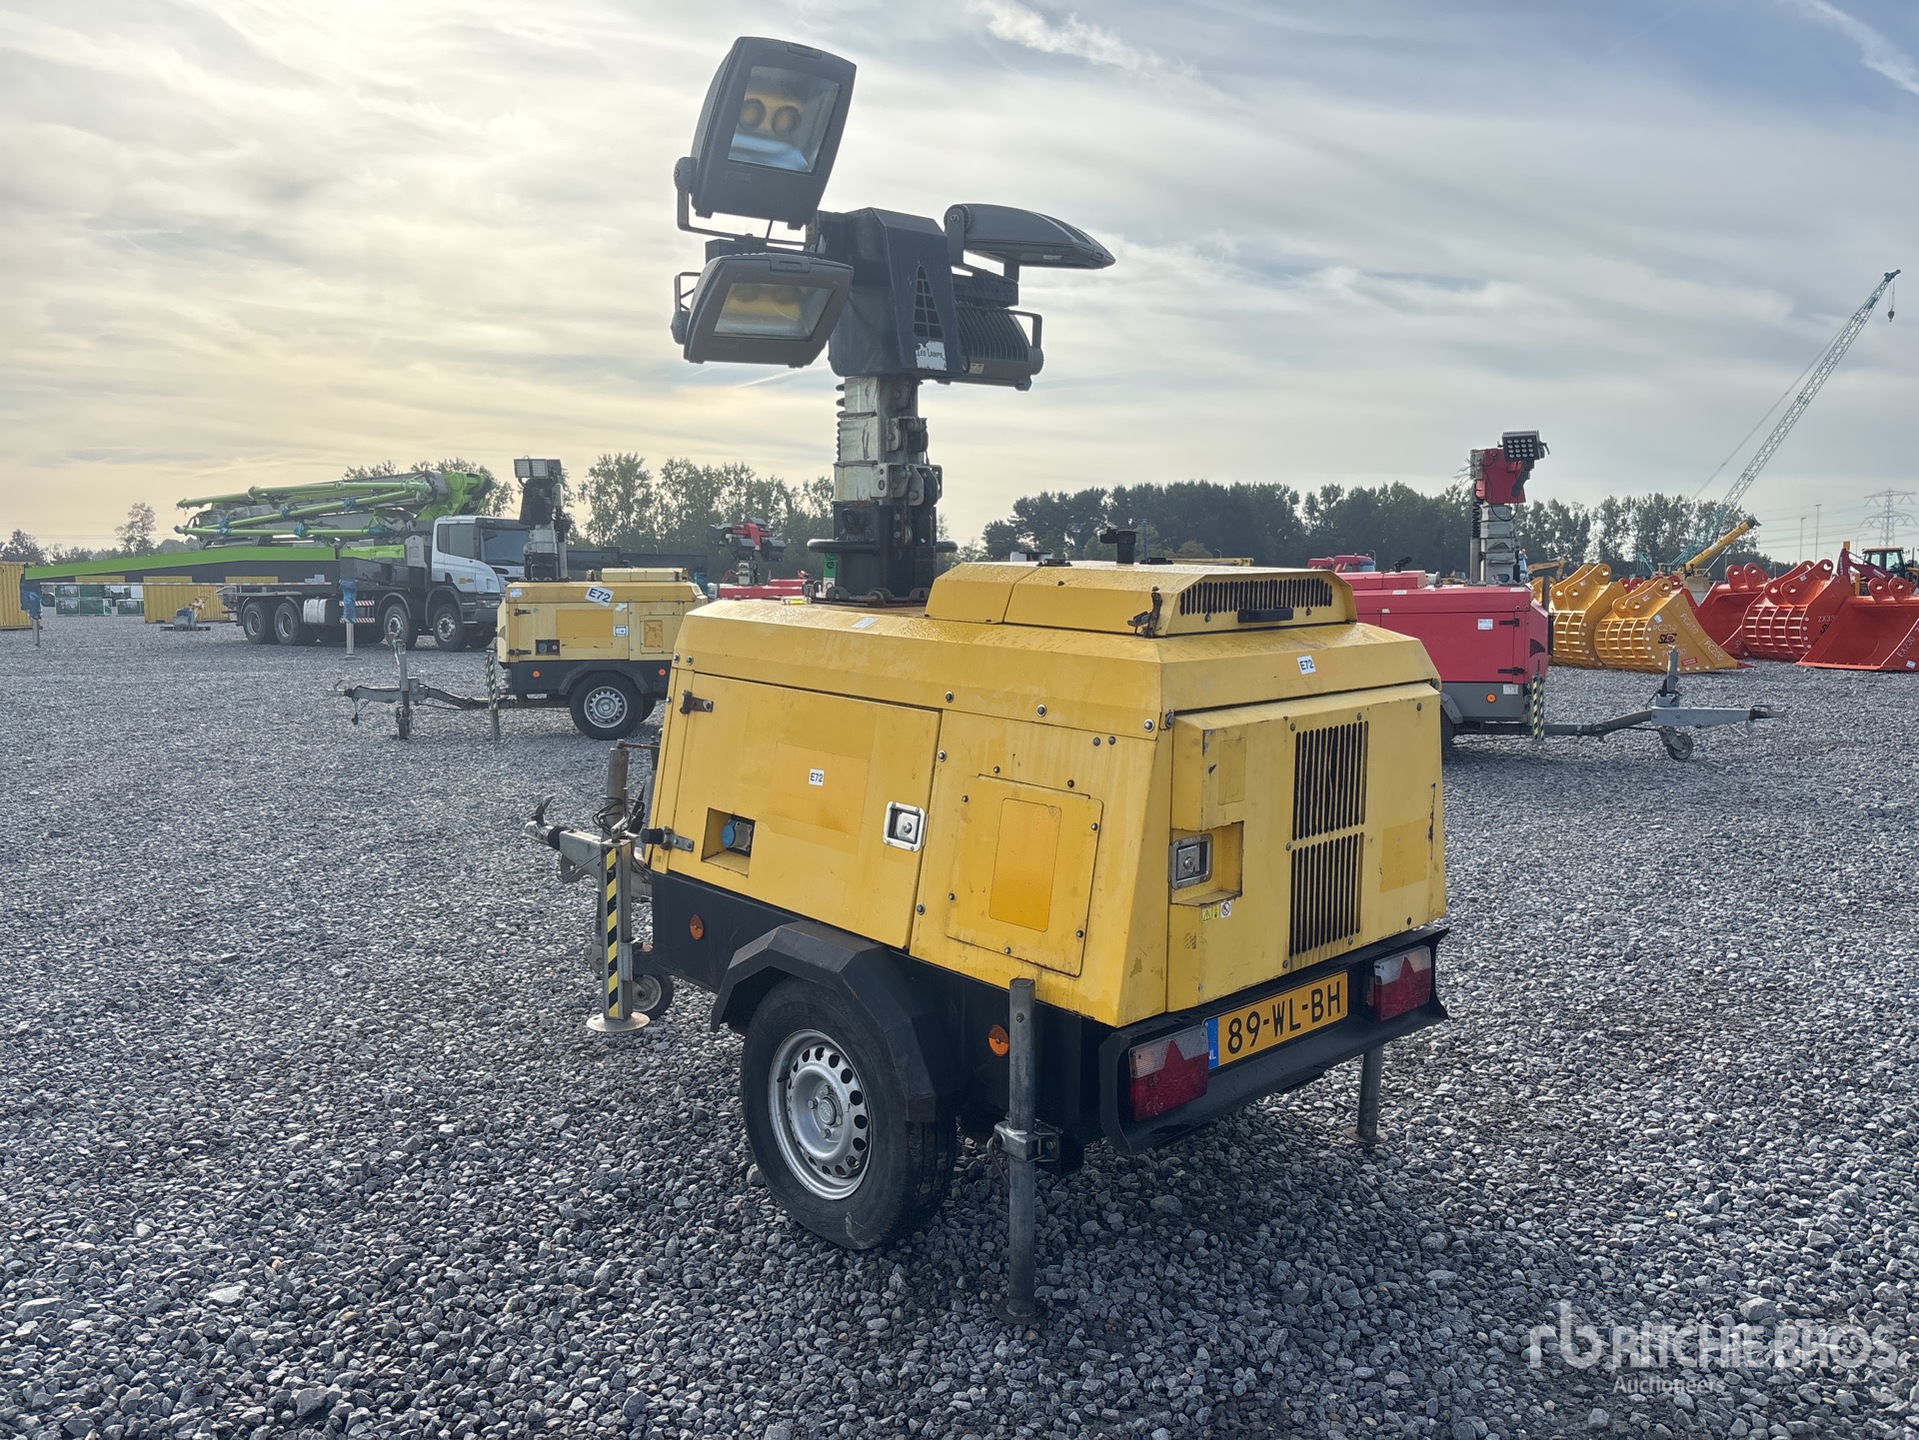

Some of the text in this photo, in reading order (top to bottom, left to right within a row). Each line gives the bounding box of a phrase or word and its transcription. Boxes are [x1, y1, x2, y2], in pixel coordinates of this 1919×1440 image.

[588, 587, 611, 603] E72
[1300, 659, 1314, 670] E72
[810, 772, 824, 783] E72
[1227, 980, 1341, 1055] 89-WL-BH
